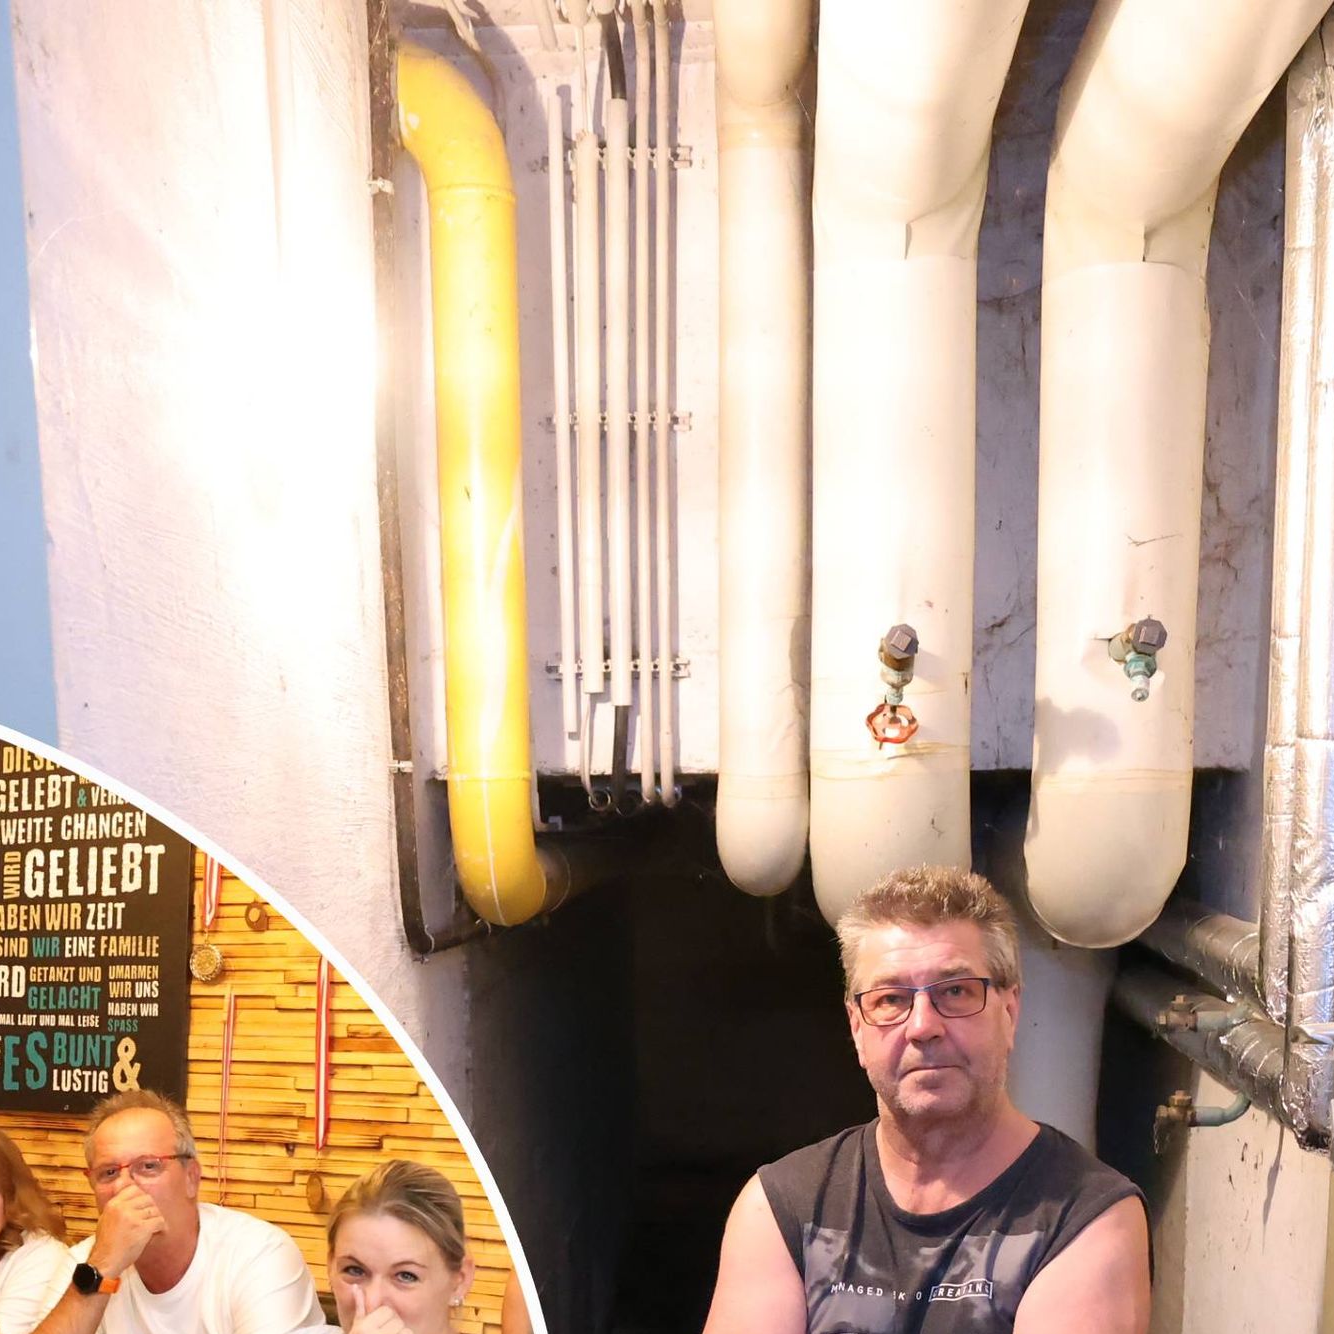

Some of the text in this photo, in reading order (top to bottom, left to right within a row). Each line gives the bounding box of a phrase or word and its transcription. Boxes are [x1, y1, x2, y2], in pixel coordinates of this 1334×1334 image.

[3, 746, 64, 774] DIES
[77, 788, 88, 808] &
[61, 810, 147, 841] CHANCEN
[3, 850, 22, 900] WIRD
[23, 842, 166, 899] GELIEBT
[45, 902, 82, 931] WIR
[86, 902, 126, 930] ZEIT
[32, 936, 60, 958] WIR
[64, 936, 96, 958] EINE
[100, 935, 160, 957] FAMILIE
[29, 966, 75, 983] GETANZT
[78, 966, 101, 983] UND
[108, 965, 159, 980] UMARMEN
[27, 985, 102, 1011] GELACHT
[109, 980, 159, 999] WIR UNS
[0, 1013, 15, 1026] MAL
[18, 1013, 37, 1027] LAUT
[39, 1014, 56, 1027] UND
[58, 1014, 75, 1027] MAL
[77, 1014, 100, 1028] LEISE
[107, 1002, 159, 1017] HABEN WIR
[107, 1018, 139, 1032] SPASS
[3, 1031, 48, 1091] ES
[53, 1031, 142, 1092] BUNT &
[52, 1069, 109, 1094] LUSTIG
